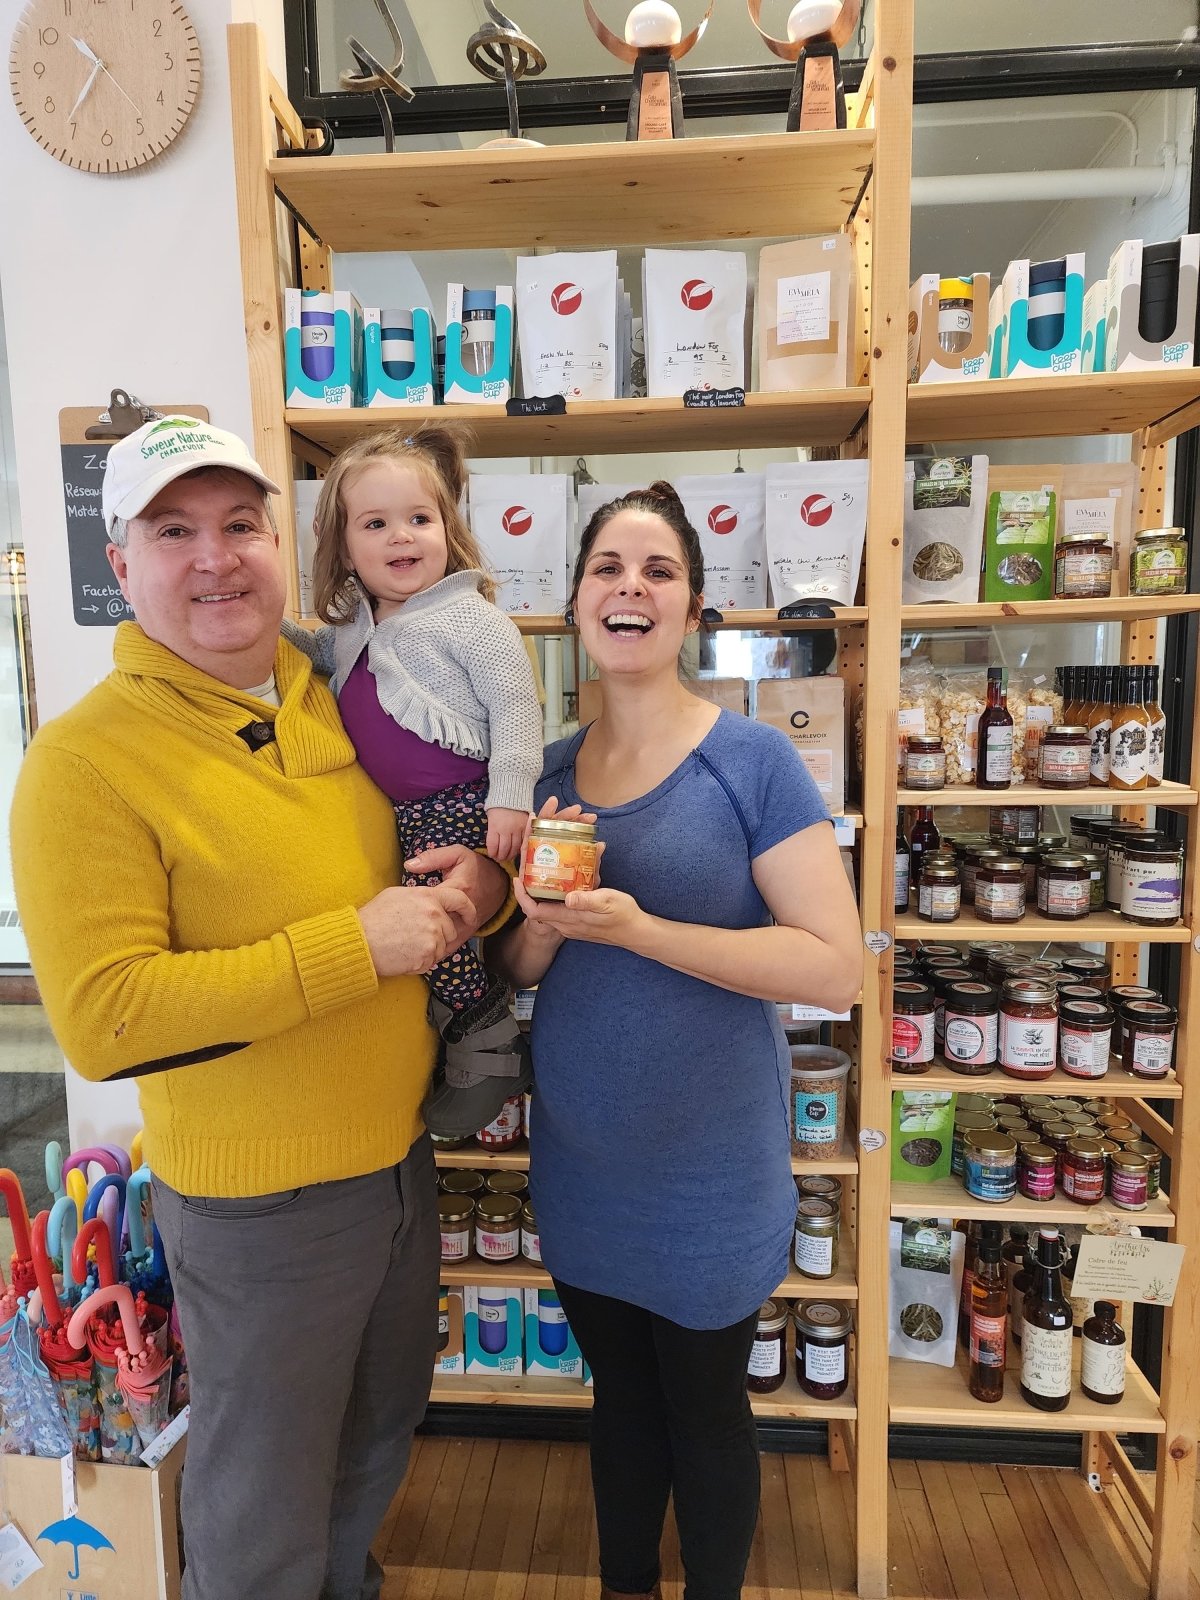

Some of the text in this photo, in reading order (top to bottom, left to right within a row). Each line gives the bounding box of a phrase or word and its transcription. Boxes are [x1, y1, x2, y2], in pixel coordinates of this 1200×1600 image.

[152, 19, 163, 38] 2
[38, 26, 59, 46] 10
[163, 52, 174, 71] 3
[33, 61, 46, 80] 9
[156, 89, 165, 106] 4
[44, 95, 56, 114] 8
[70, 122, 77, 140] 7
[136, 117, 145, 136] 5
[101, 129, 113, 147] 6
[708, 341, 720, 353] Fog
[1163, 343, 1189, 354] keep
[668, 356, 674, 364] 2
[962, 357, 985, 368] keep
[1051, 352, 1077, 364] keep
[1163, 351, 1183, 363] cup
[963, 366, 980, 376] cup
[1052, 361, 1072, 373] cup
[324, 386, 347, 397] keep
[406, 386, 429, 398] keep
[482, 381, 505, 392] keep
[326, 394, 342, 404] cup
[408, 392, 425, 403] cup
[483, 388, 500, 399] cup
[140, 432, 212, 460] Saveur Nature
[160, 443, 206, 460] CHARLEVOIX
[441, 1356, 460, 1365] keep
[442, 1362, 456, 1371] cup
[499, 1358, 518, 1366] keep
[559, 1359, 579, 1367] keep
[500, 1364, 515, 1372] cup
[560, 1365, 575, 1374] cup
